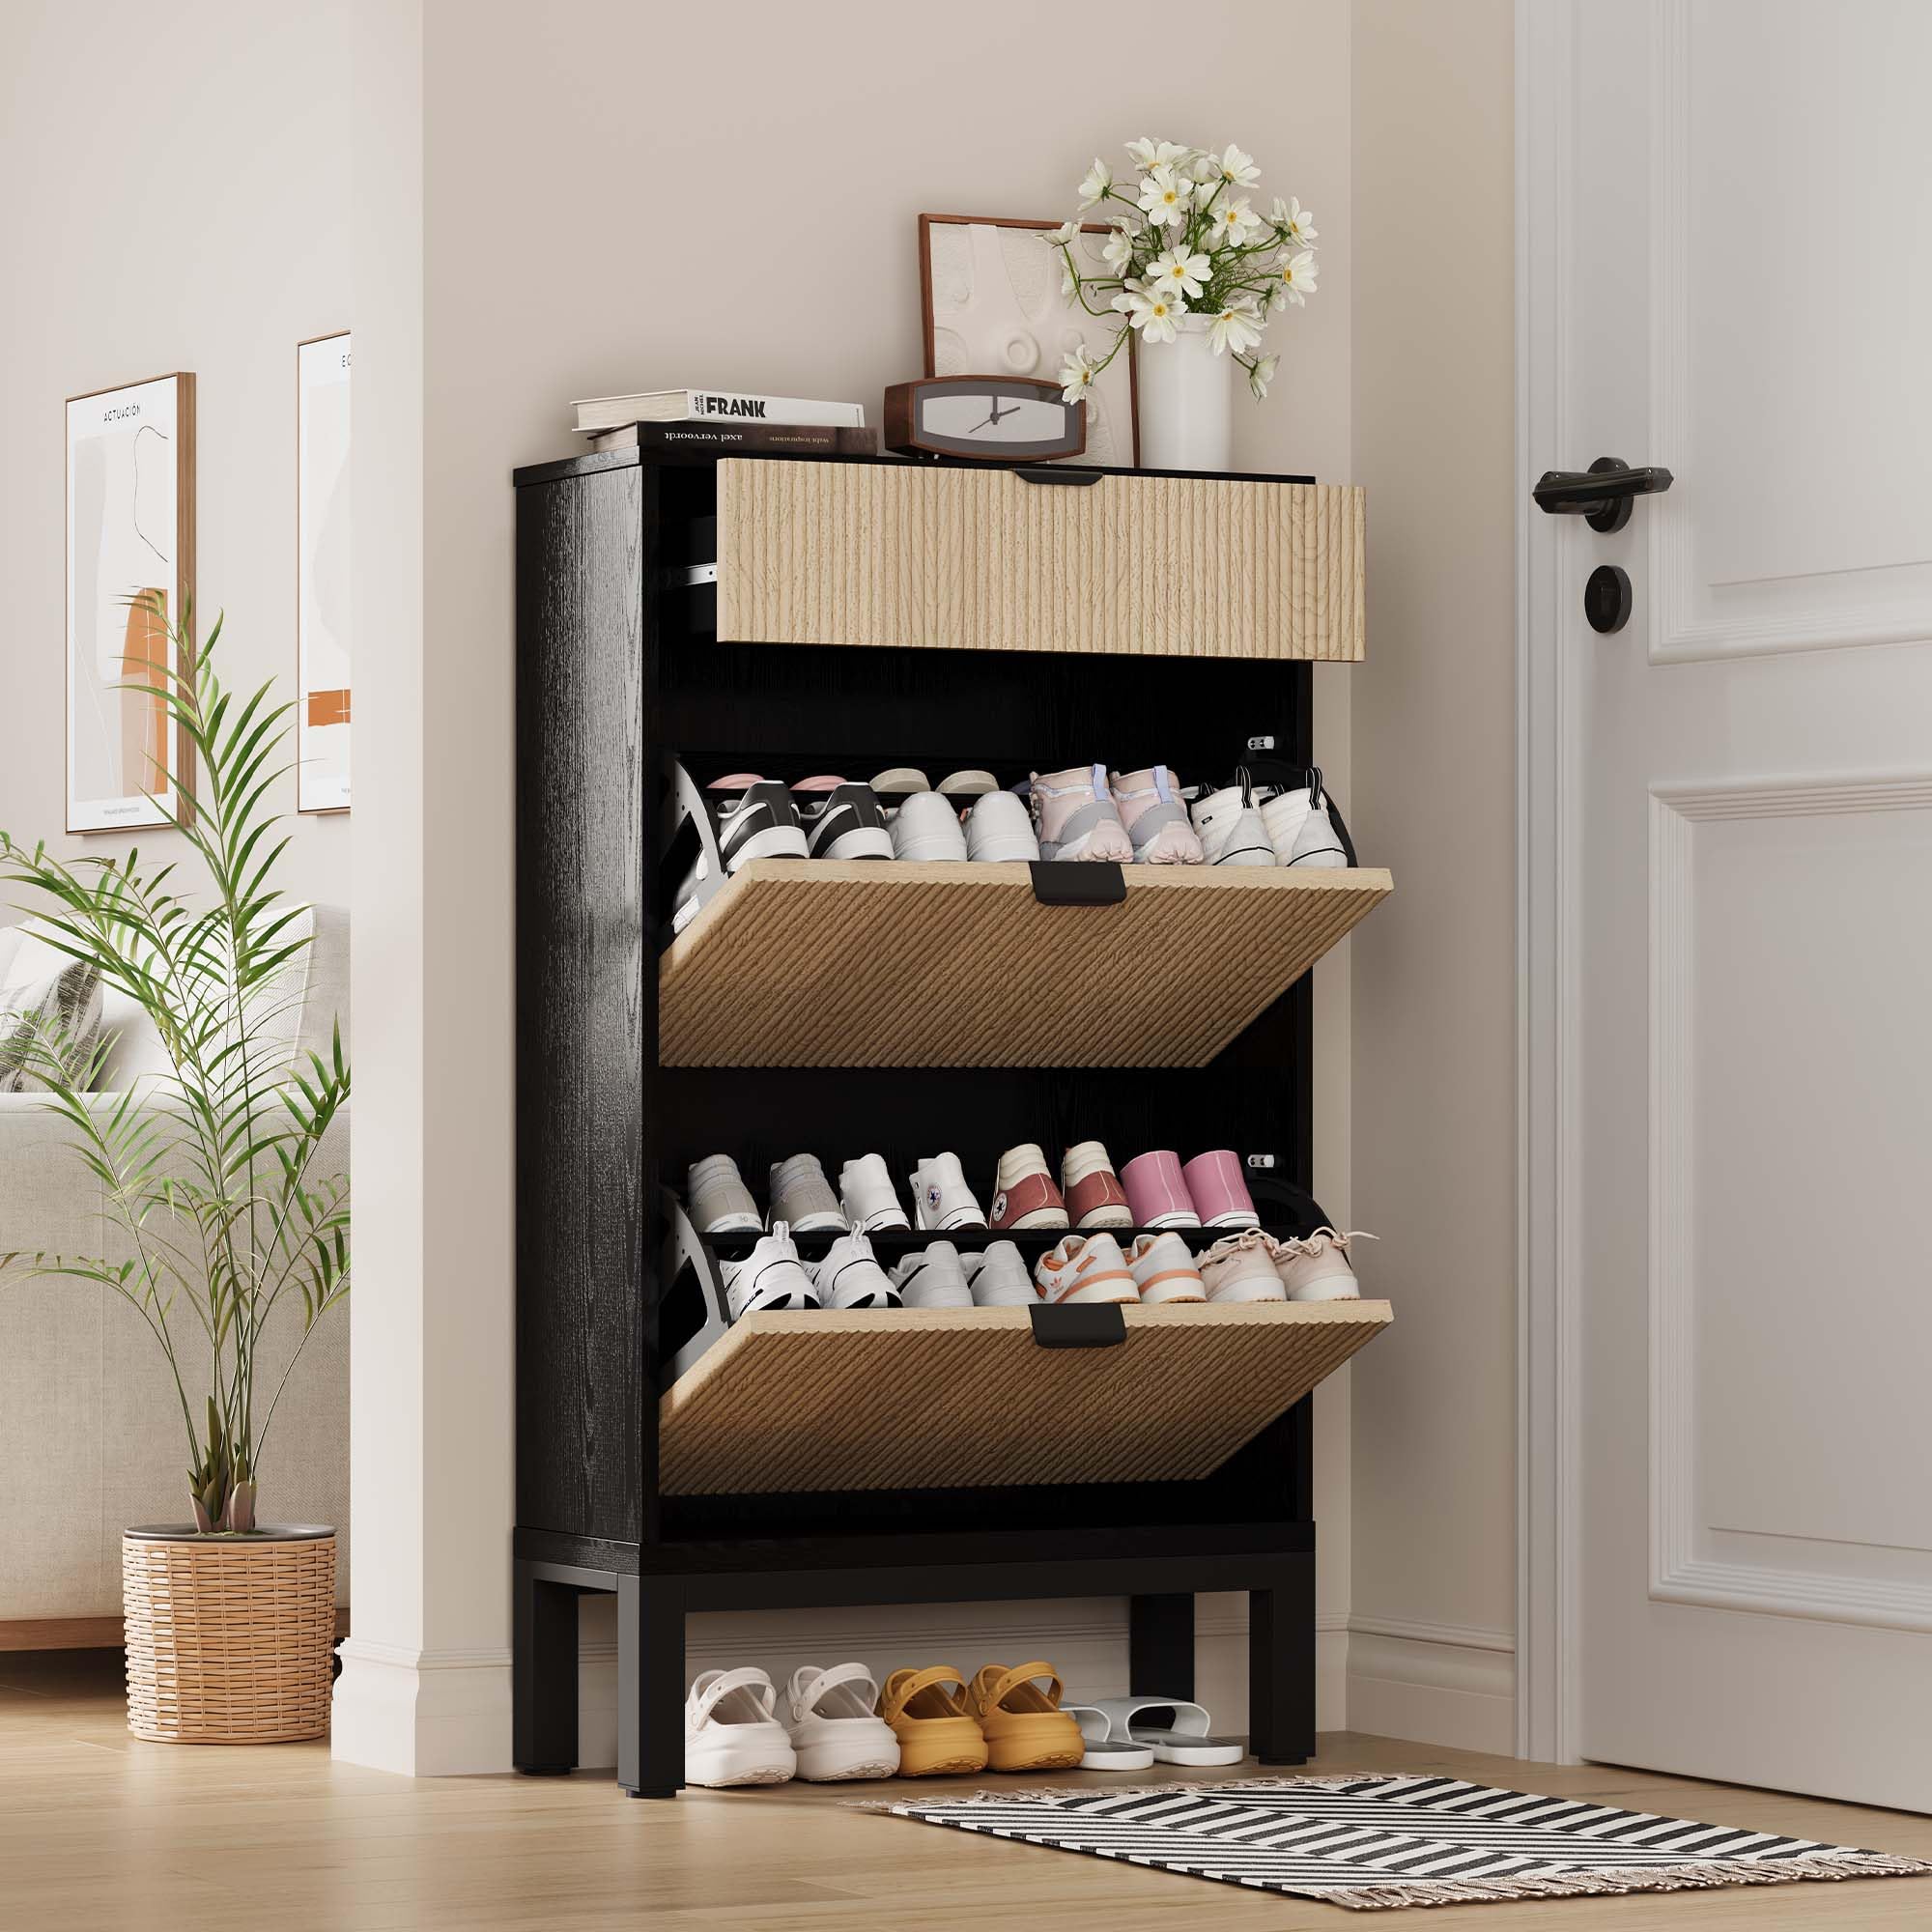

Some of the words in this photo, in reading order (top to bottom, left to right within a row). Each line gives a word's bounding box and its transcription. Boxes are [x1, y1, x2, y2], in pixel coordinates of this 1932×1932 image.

[103, 402, 141, 422] ACTUACIÓN
[706, 396, 766, 418] FRANK
[664, 432, 718, 441] vervoordt
[720, 434, 743, 442] axel
